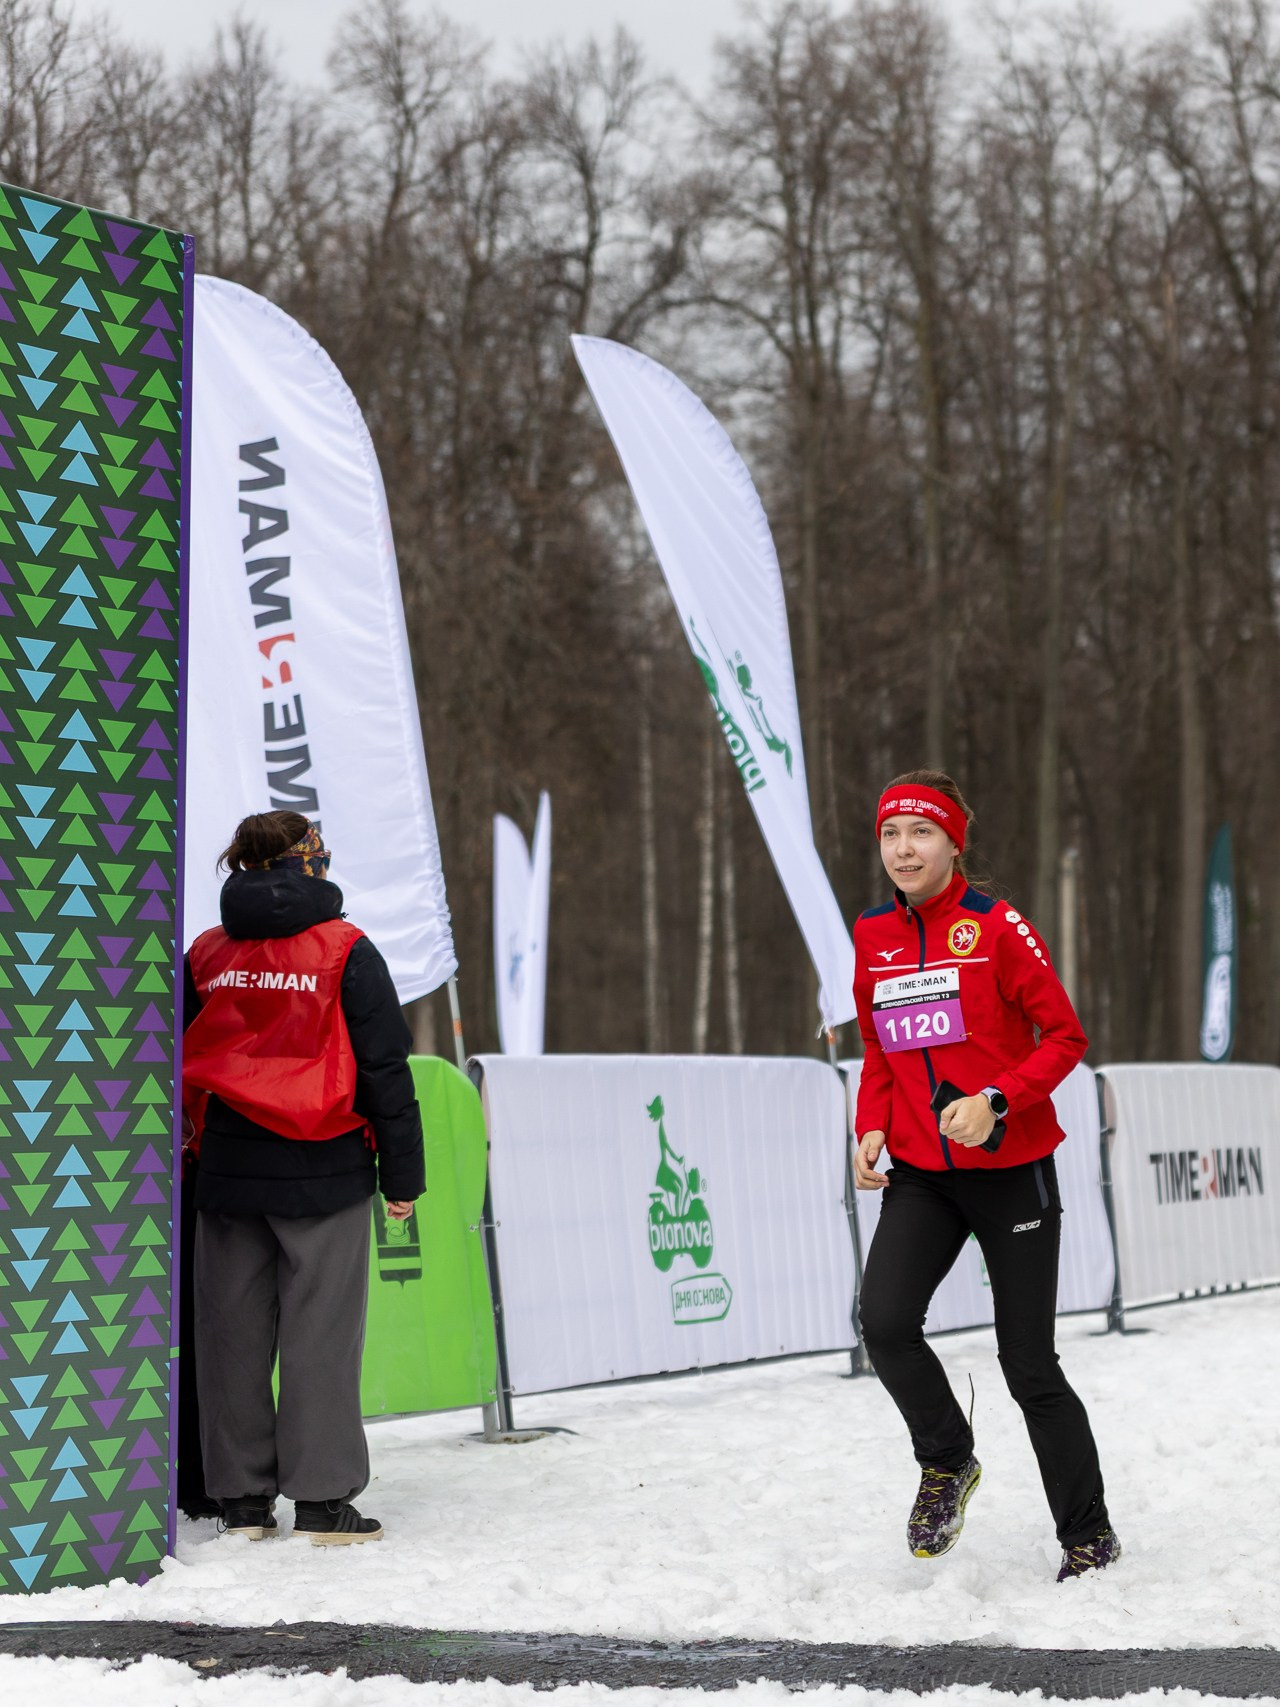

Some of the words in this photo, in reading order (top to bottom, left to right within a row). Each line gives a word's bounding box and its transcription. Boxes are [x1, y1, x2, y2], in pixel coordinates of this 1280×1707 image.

[899, 798, 916, 807] WORLD
[885, 1010, 950, 1043] 1120
[1149, 1146, 1264, 1205] TIMERMAN
[649, 1211, 713, 1252] bionova
